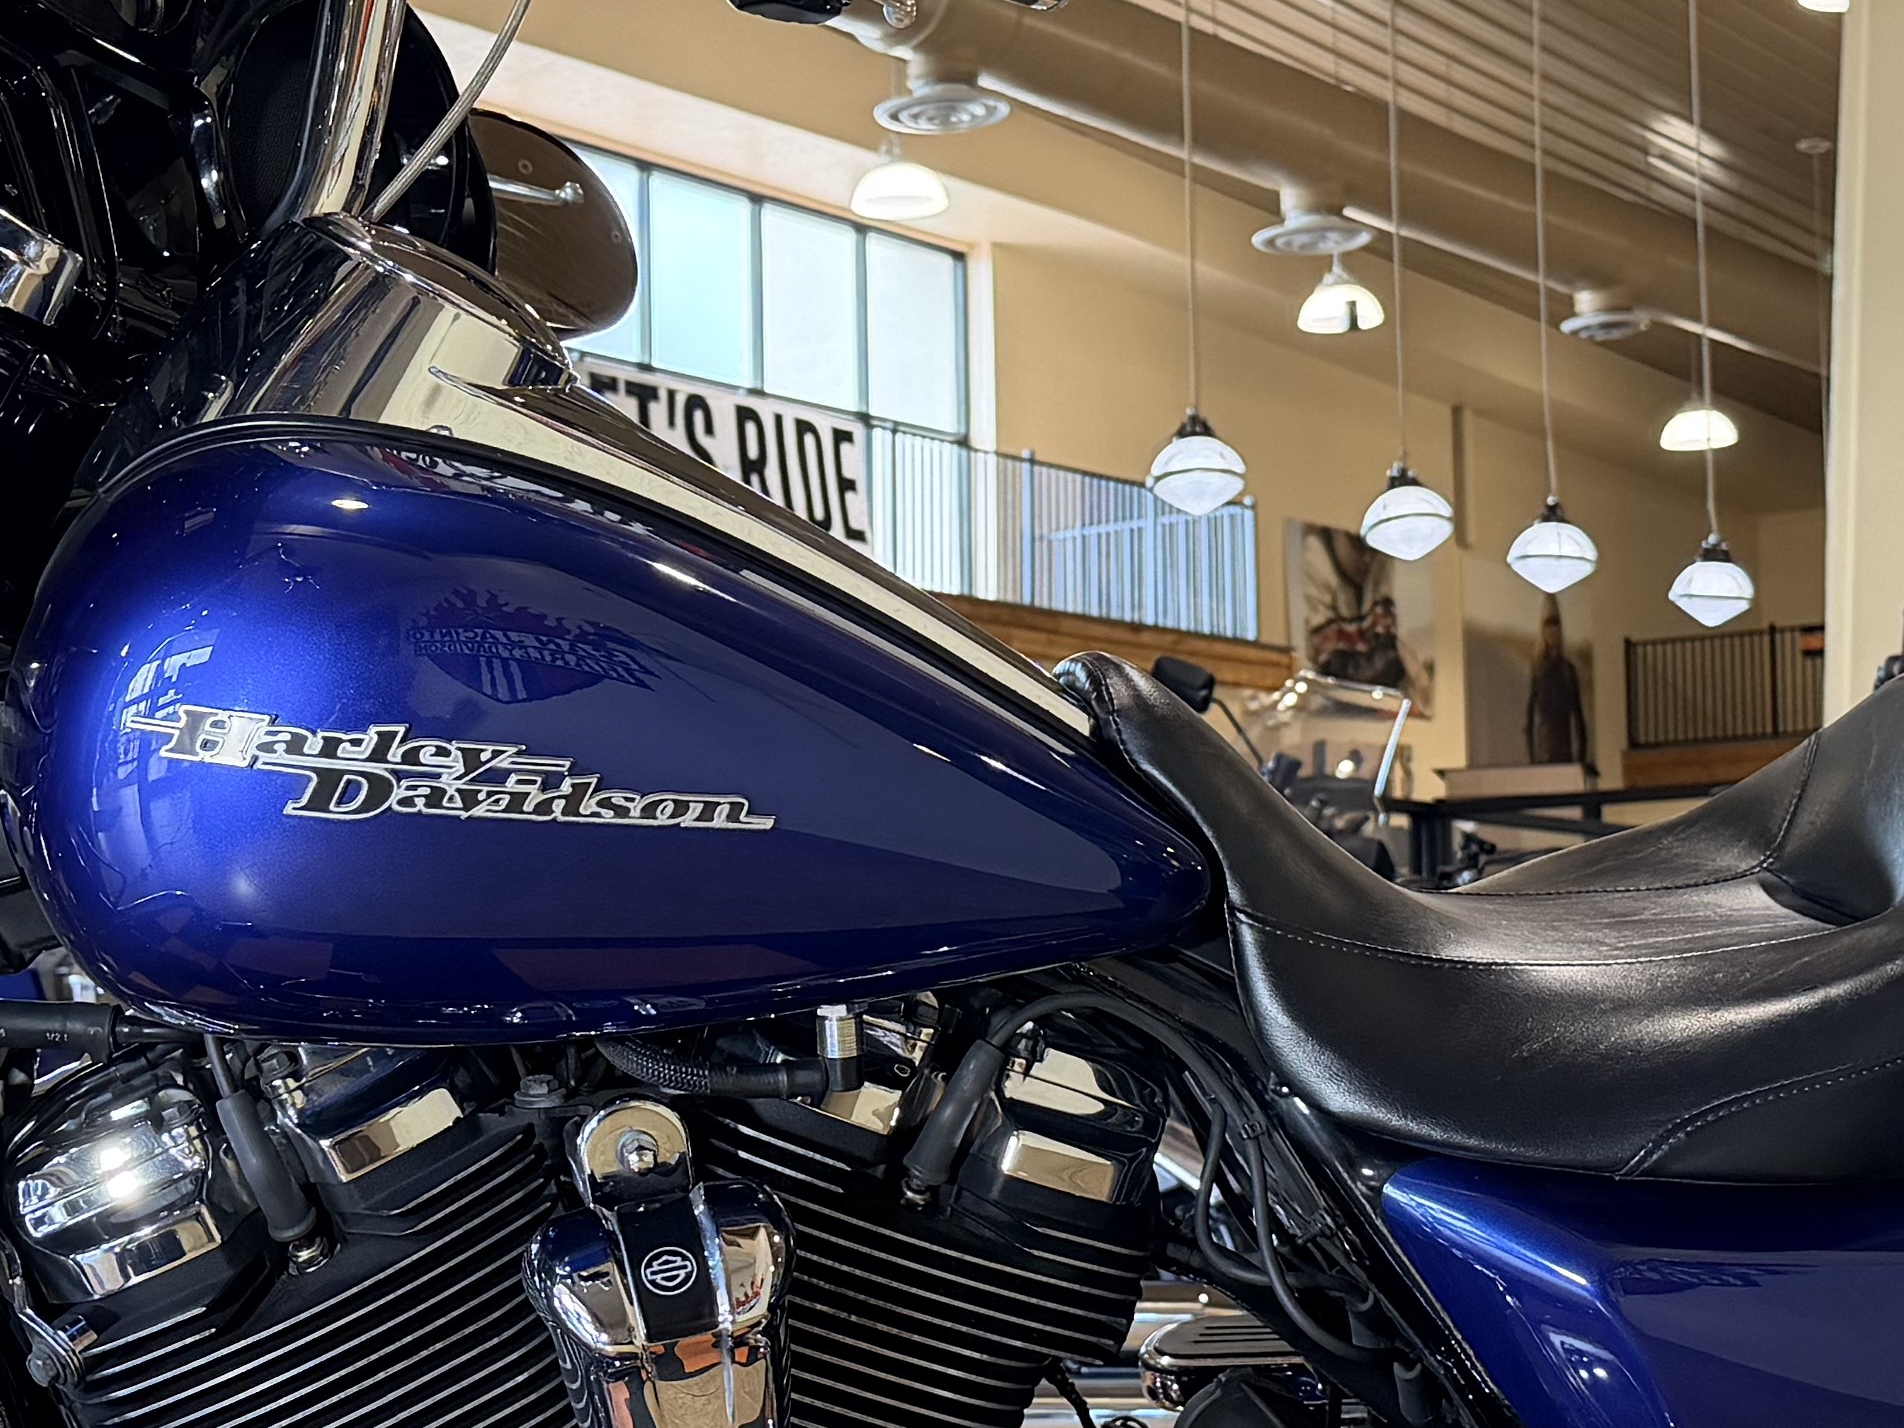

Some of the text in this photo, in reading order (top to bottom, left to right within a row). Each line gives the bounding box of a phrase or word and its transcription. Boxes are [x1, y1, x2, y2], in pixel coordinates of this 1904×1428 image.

[734, 403, 867, 545] RIDE
[136, 703, 546, 783] Harley
[284, 764, 776, 830] Davidson
